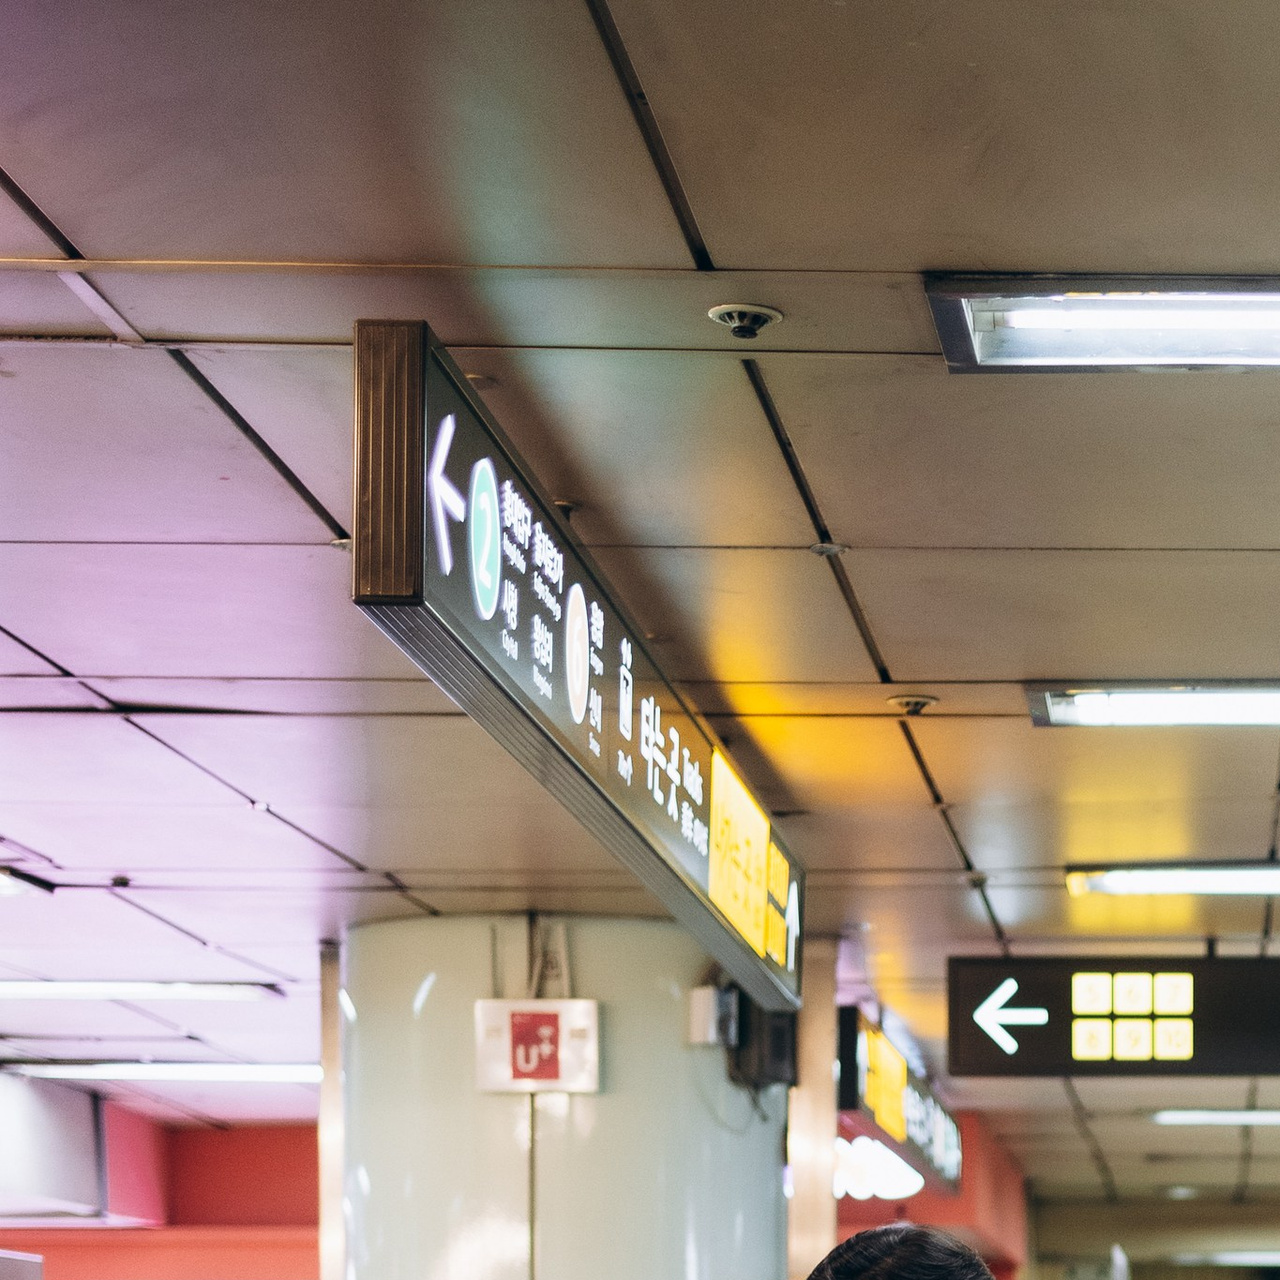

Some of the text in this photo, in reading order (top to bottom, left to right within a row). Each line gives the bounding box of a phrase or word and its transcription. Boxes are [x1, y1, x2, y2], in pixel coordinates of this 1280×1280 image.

[478, 492, 492, 589] 2
[641, 696, 681, 823] 타는 곳
